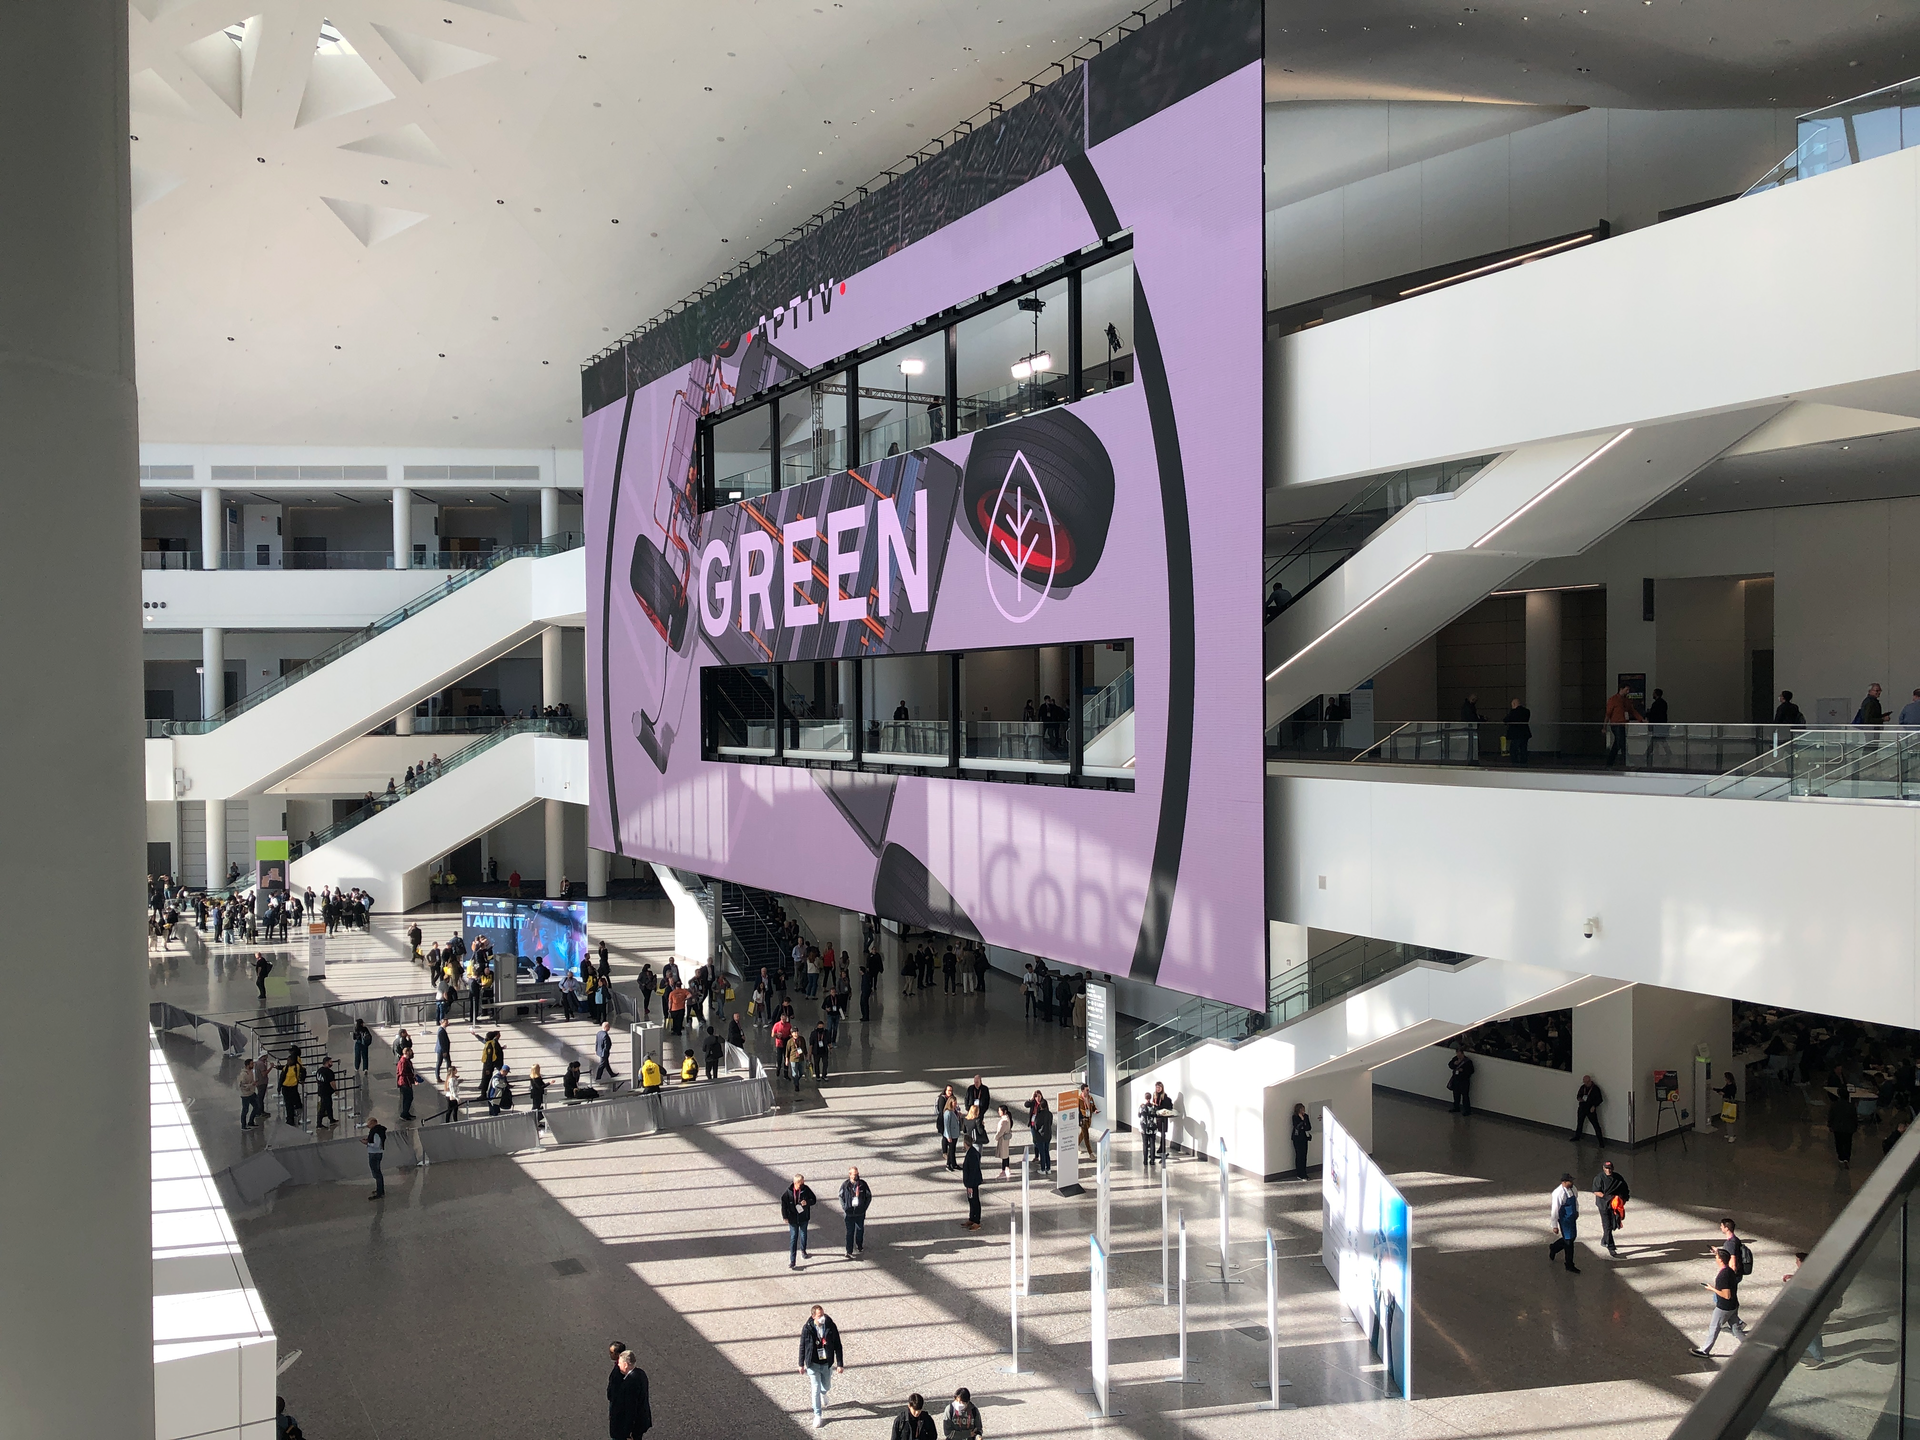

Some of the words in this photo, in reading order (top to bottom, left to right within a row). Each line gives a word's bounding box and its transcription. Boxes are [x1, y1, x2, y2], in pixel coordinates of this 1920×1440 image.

[757, 278, 834, 348] APTIV
[699, 489, 928, 637] GREEN
[473, 916, 495, 928] AM
[497, 916, 510, 929] IN
